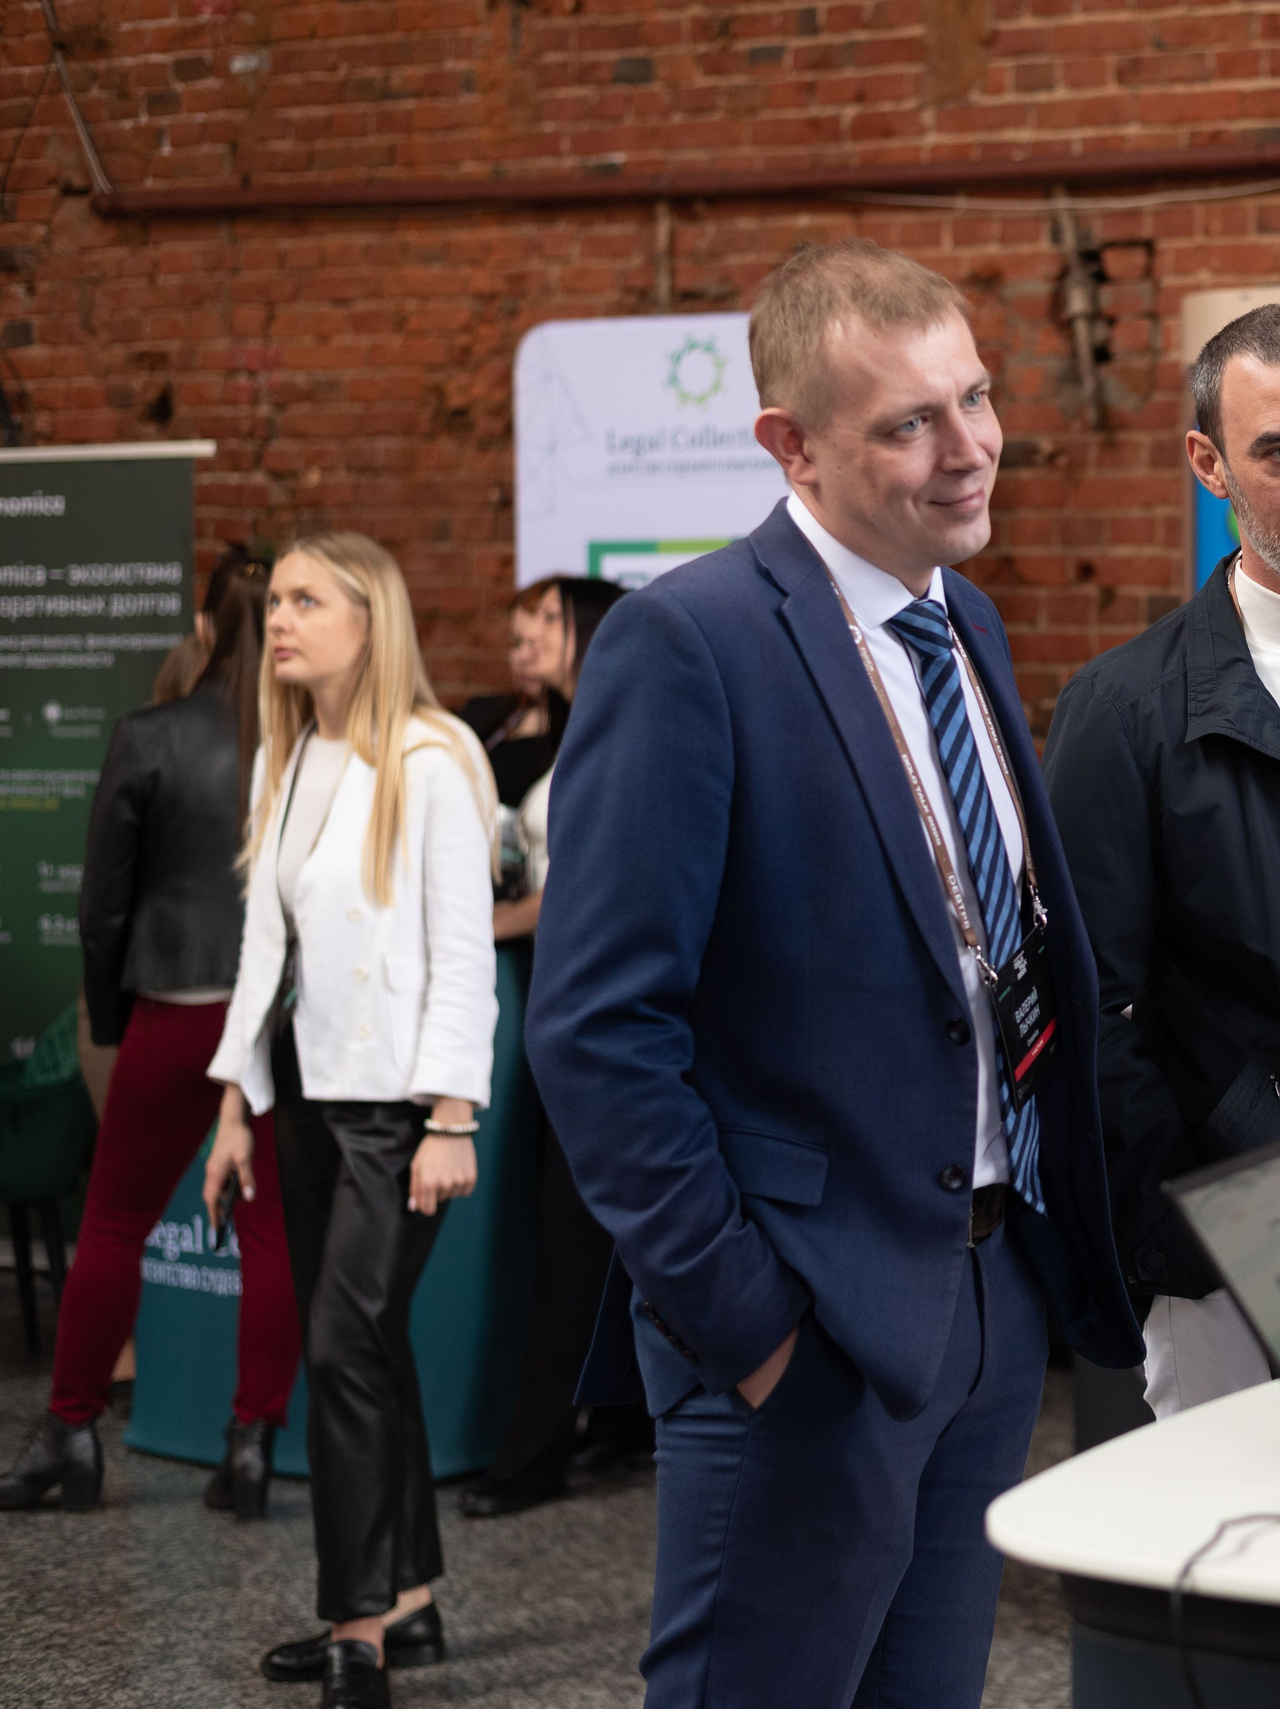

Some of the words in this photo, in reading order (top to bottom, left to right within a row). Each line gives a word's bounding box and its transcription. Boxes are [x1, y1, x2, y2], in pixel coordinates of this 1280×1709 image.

[604, 427, 666, 456] Legal
[66, 562, 183, 587] экосистема
[108, 592, 182, 619] долгов
[902, 754, 918, 784] DOLG
[915, 786, 928, 812] TALK
[1014, 985, 1039, 1024] ВАЛЕРИЙ
